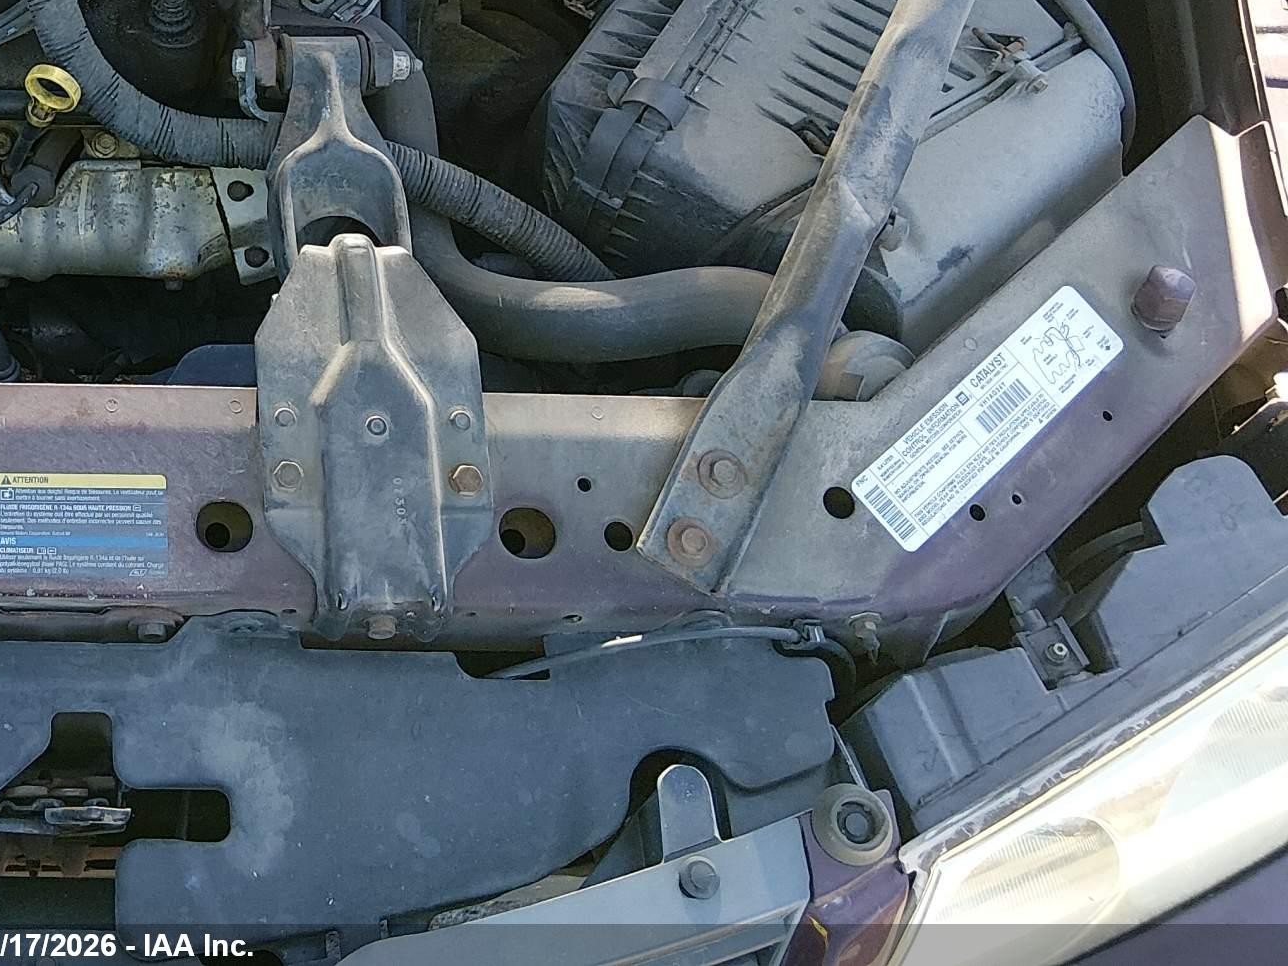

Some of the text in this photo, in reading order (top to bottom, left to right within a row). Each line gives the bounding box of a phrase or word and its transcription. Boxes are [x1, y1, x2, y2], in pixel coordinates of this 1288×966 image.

[968, 352, 1006, 388] CATALYST
[901, 401, 960, 457] CONTROL INFORMATION
[902, 401, 948, 445] VEHICLE EMISSION
